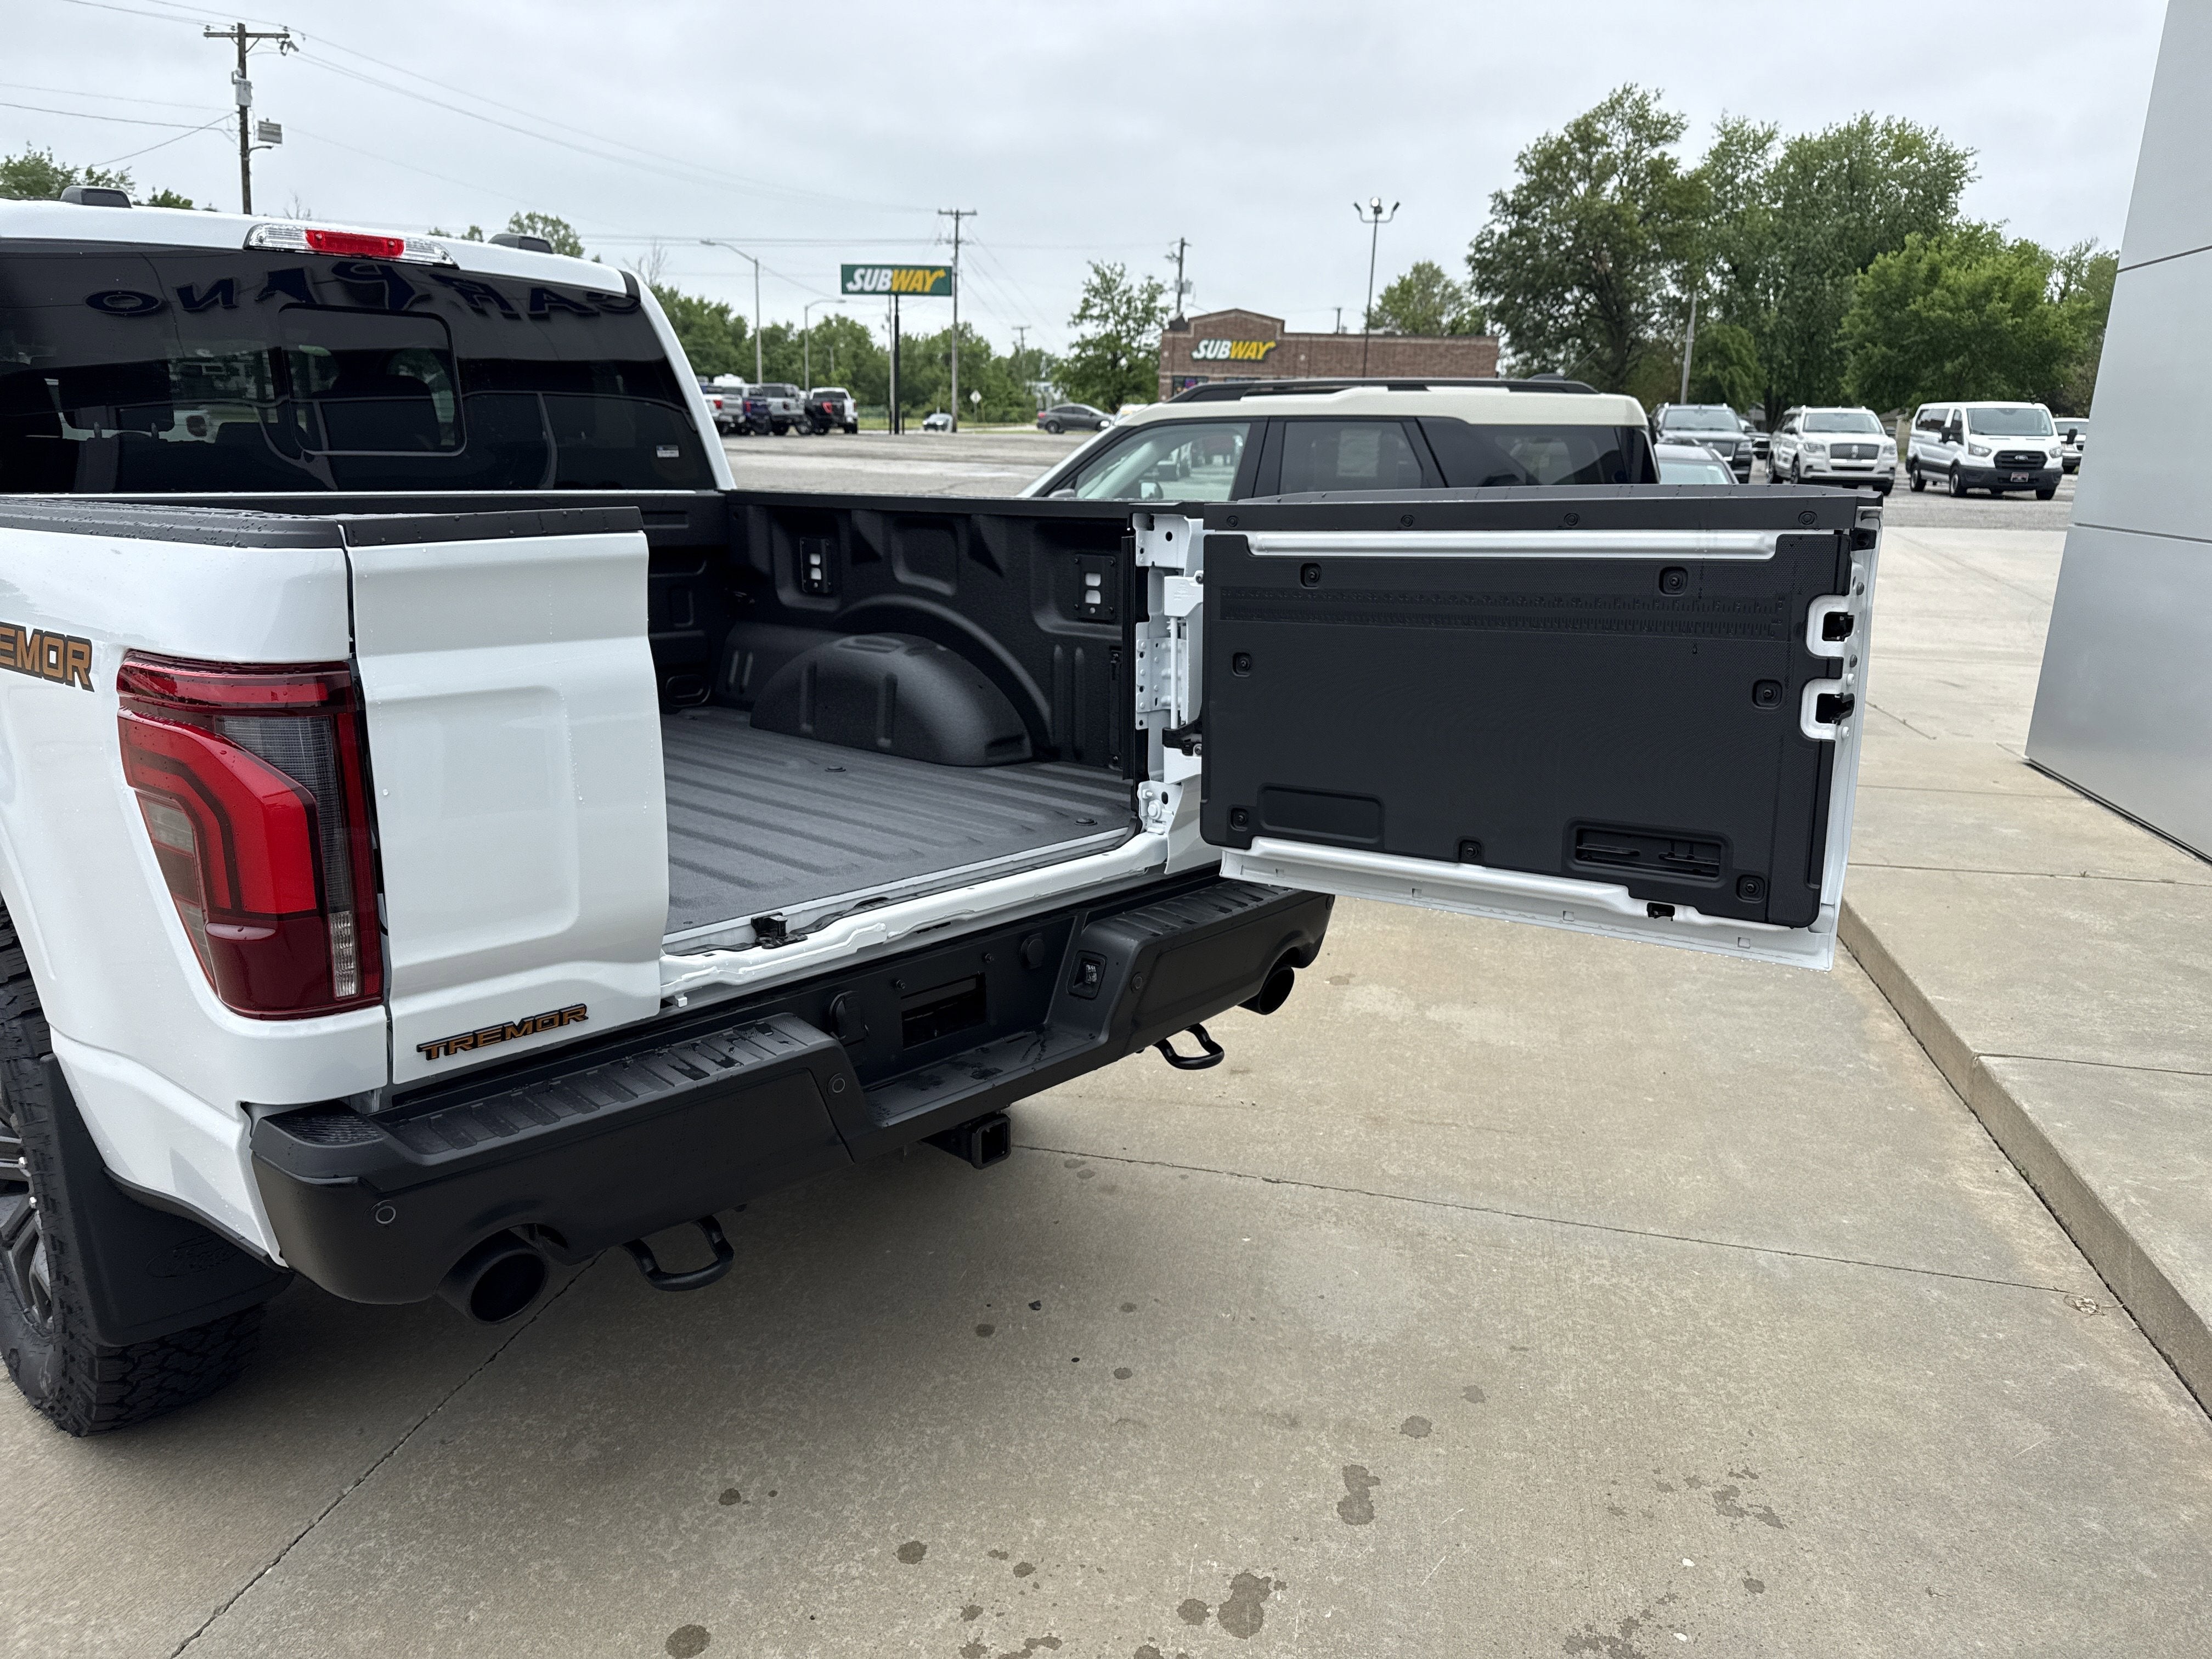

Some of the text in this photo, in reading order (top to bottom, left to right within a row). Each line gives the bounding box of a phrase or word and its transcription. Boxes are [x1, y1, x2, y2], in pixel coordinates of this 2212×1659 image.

[846, 268, 946, 292] SUBWAY
[1191, 340, 1277, 360] SUBWAY
[416, 1003, 589, 1060] TREMOR
